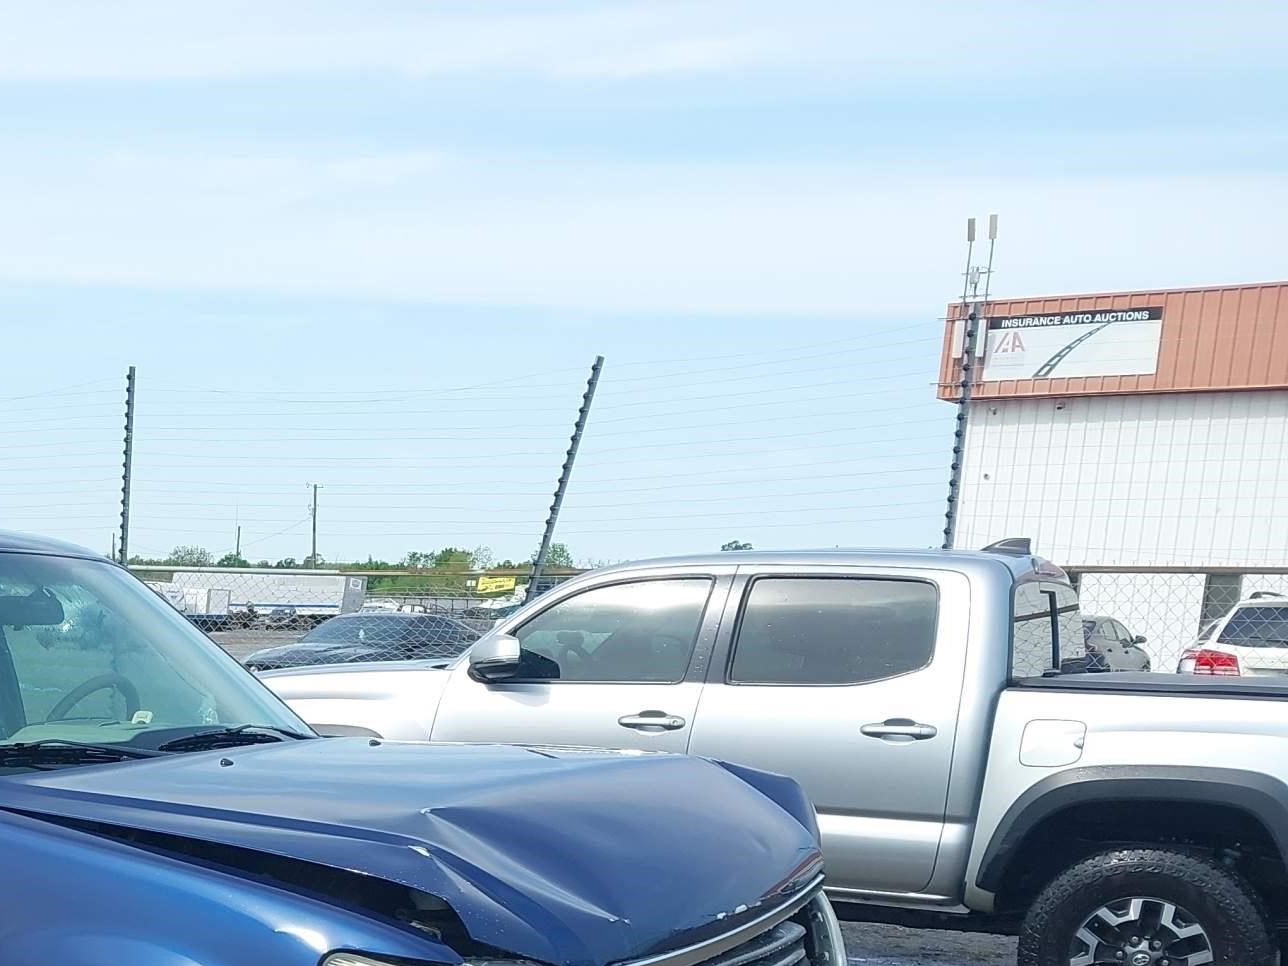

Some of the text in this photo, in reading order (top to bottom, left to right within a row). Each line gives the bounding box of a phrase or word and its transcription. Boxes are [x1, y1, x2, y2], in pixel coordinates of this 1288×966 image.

[1001, 310, 1150, 328] INSURANCE AUTO AUCTIONS
